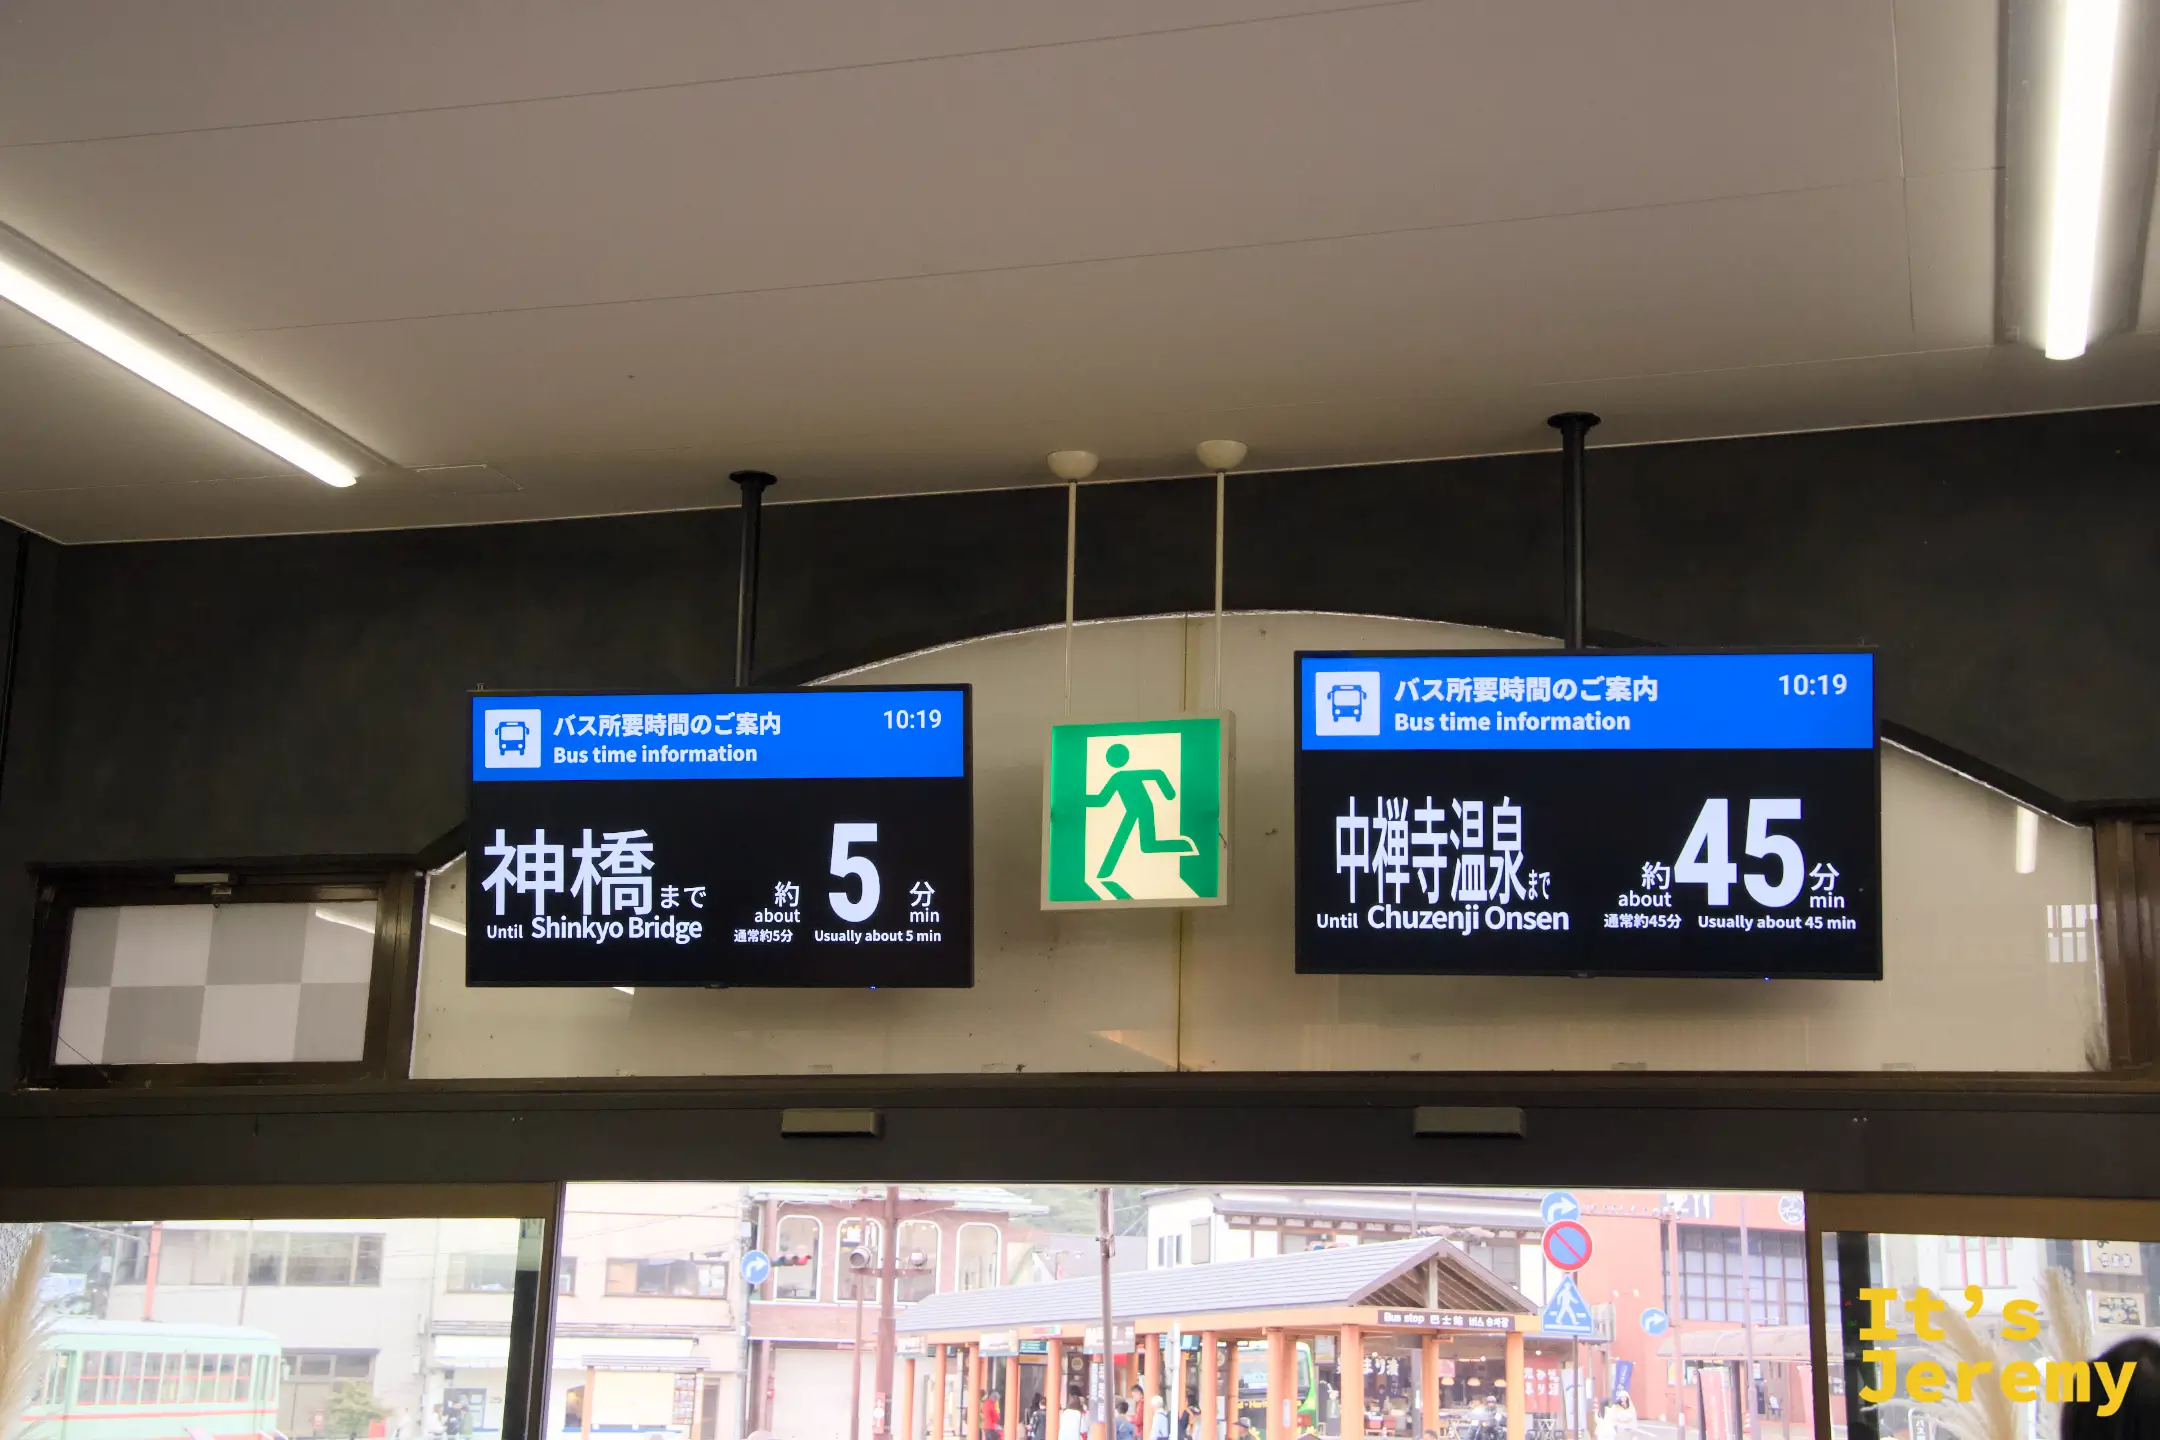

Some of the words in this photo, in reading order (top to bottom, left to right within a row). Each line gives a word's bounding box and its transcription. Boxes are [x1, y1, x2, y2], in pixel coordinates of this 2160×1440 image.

[1394, 673, 1659, 703] バス所要時間のご案内
[1778, 673, 1848, 696] 10:19
[553, 711, 781, 738] バス所要時間のご案内
[883, 709, 942, 730] 10:19
[1394, 712, 1435, 732] Bus
[1439, 711, 1492, 731] time
[1496, 710, 1631, 731] information
[553, 746, 589, 764] Bus
[592, 744, 638, 764] time
[641, 743, 757, 763] information
[1641, 861, 1671, 891] 約
[1673, 797, 1806, 908] 45
[1808, 862, 1840, 892] 分
[774, 880, 800, 907] 約
[828, 822, 881, 923] 5
[909, 880, 936, 907] 分
[1618, 890, 1672, 908] about
[1809, 893, 1846, 909] min
[754, 907, 801, 923] about
[909, 908, 940, 923] min
[1316, 912, 1359, 930] Until
[1367, 904, 1480, 936] Chuzenji
[1484, 905, 1570, 931] Onsen
[1603, 913, 1683, 930] 通常約45分
[1697, 914, 1754, 932] Usually
[1756, 914, 1803, 930] about
[1804, 915, 1824, 930] 45
[1826, 915, 1857, 931] min
[486, 923, 524, 939] Until
[531, 915, 624, 945] Shinkyo
[628, 915, 703, 945] Bridge
[733, 928, 794, 943] 通常約5分
[814, 929, 863, 945] Usually
[864, 929, 903, 942] about
[905, 929, 914, 942] 5
[916, 929, 942, 942] min
[1384, 1312, 1401, 1322] Bus
[1404, 1314, 1425, 1324] stop
